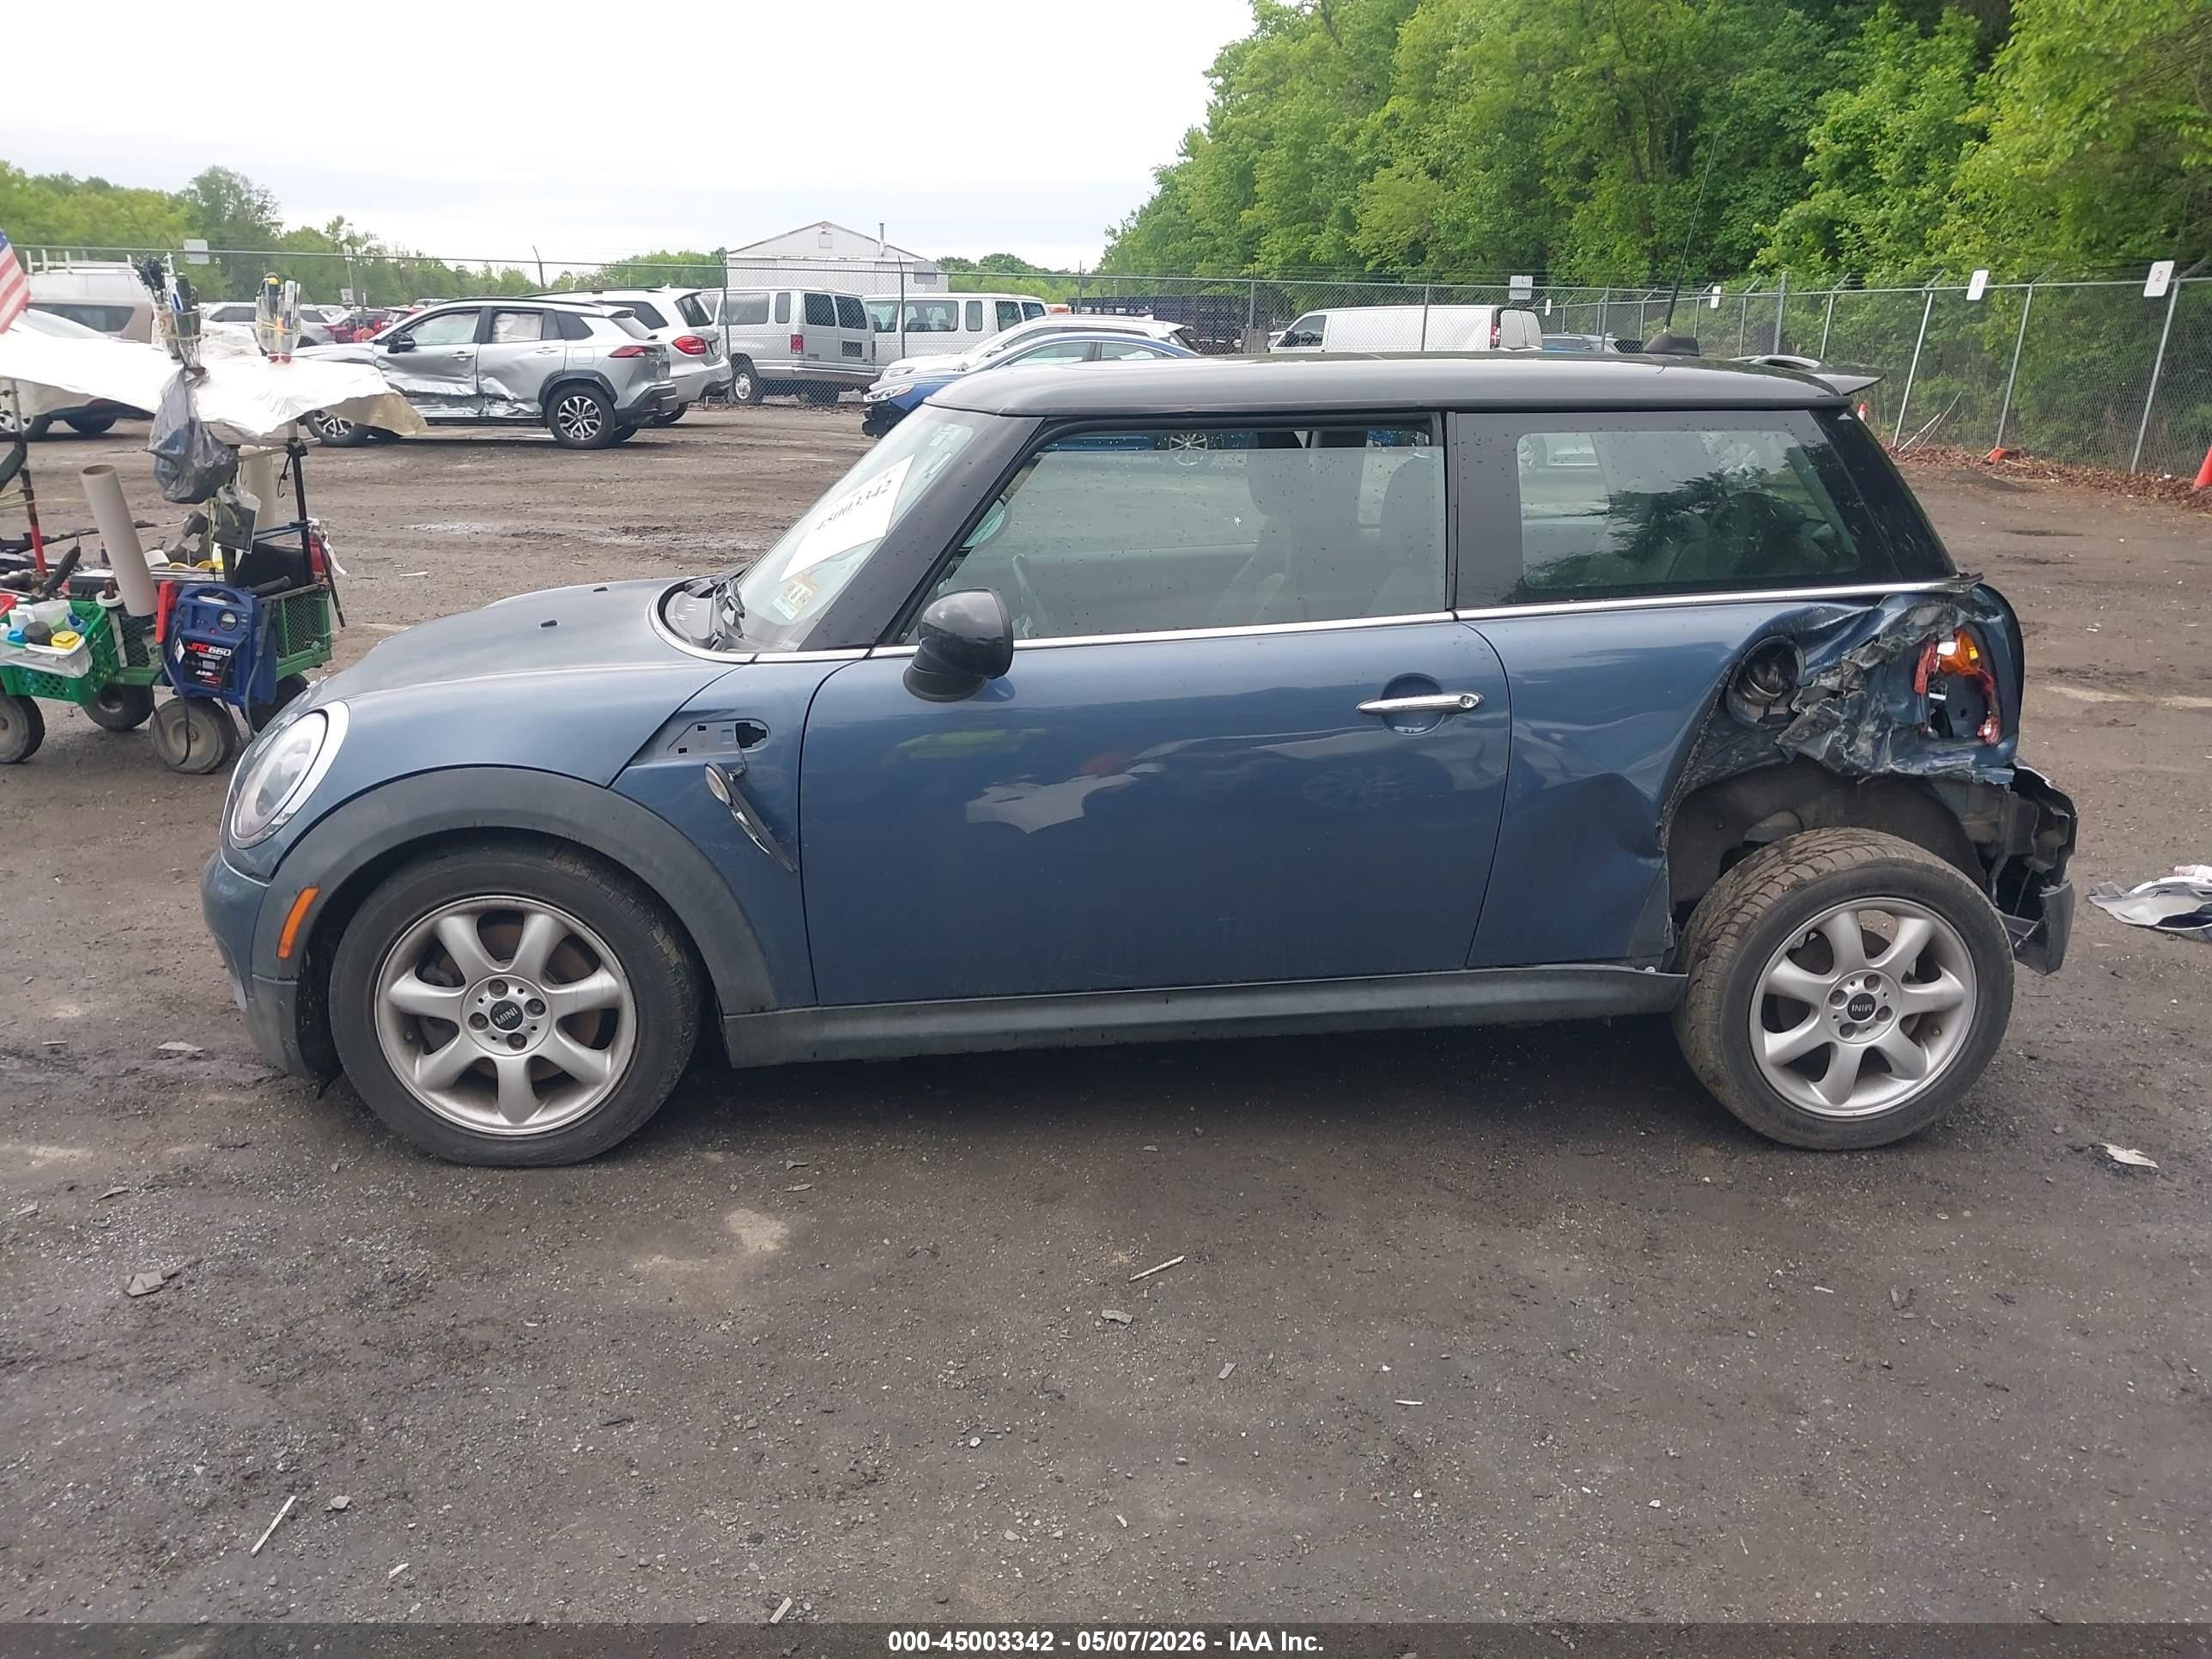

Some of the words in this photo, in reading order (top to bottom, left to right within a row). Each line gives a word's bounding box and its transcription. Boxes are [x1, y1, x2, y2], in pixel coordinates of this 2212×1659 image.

[2154, 270, 2164, 283] 2
[1850, 1004, 1873, 1012] MINI
[495, 1006, 519, 1025] MINI
